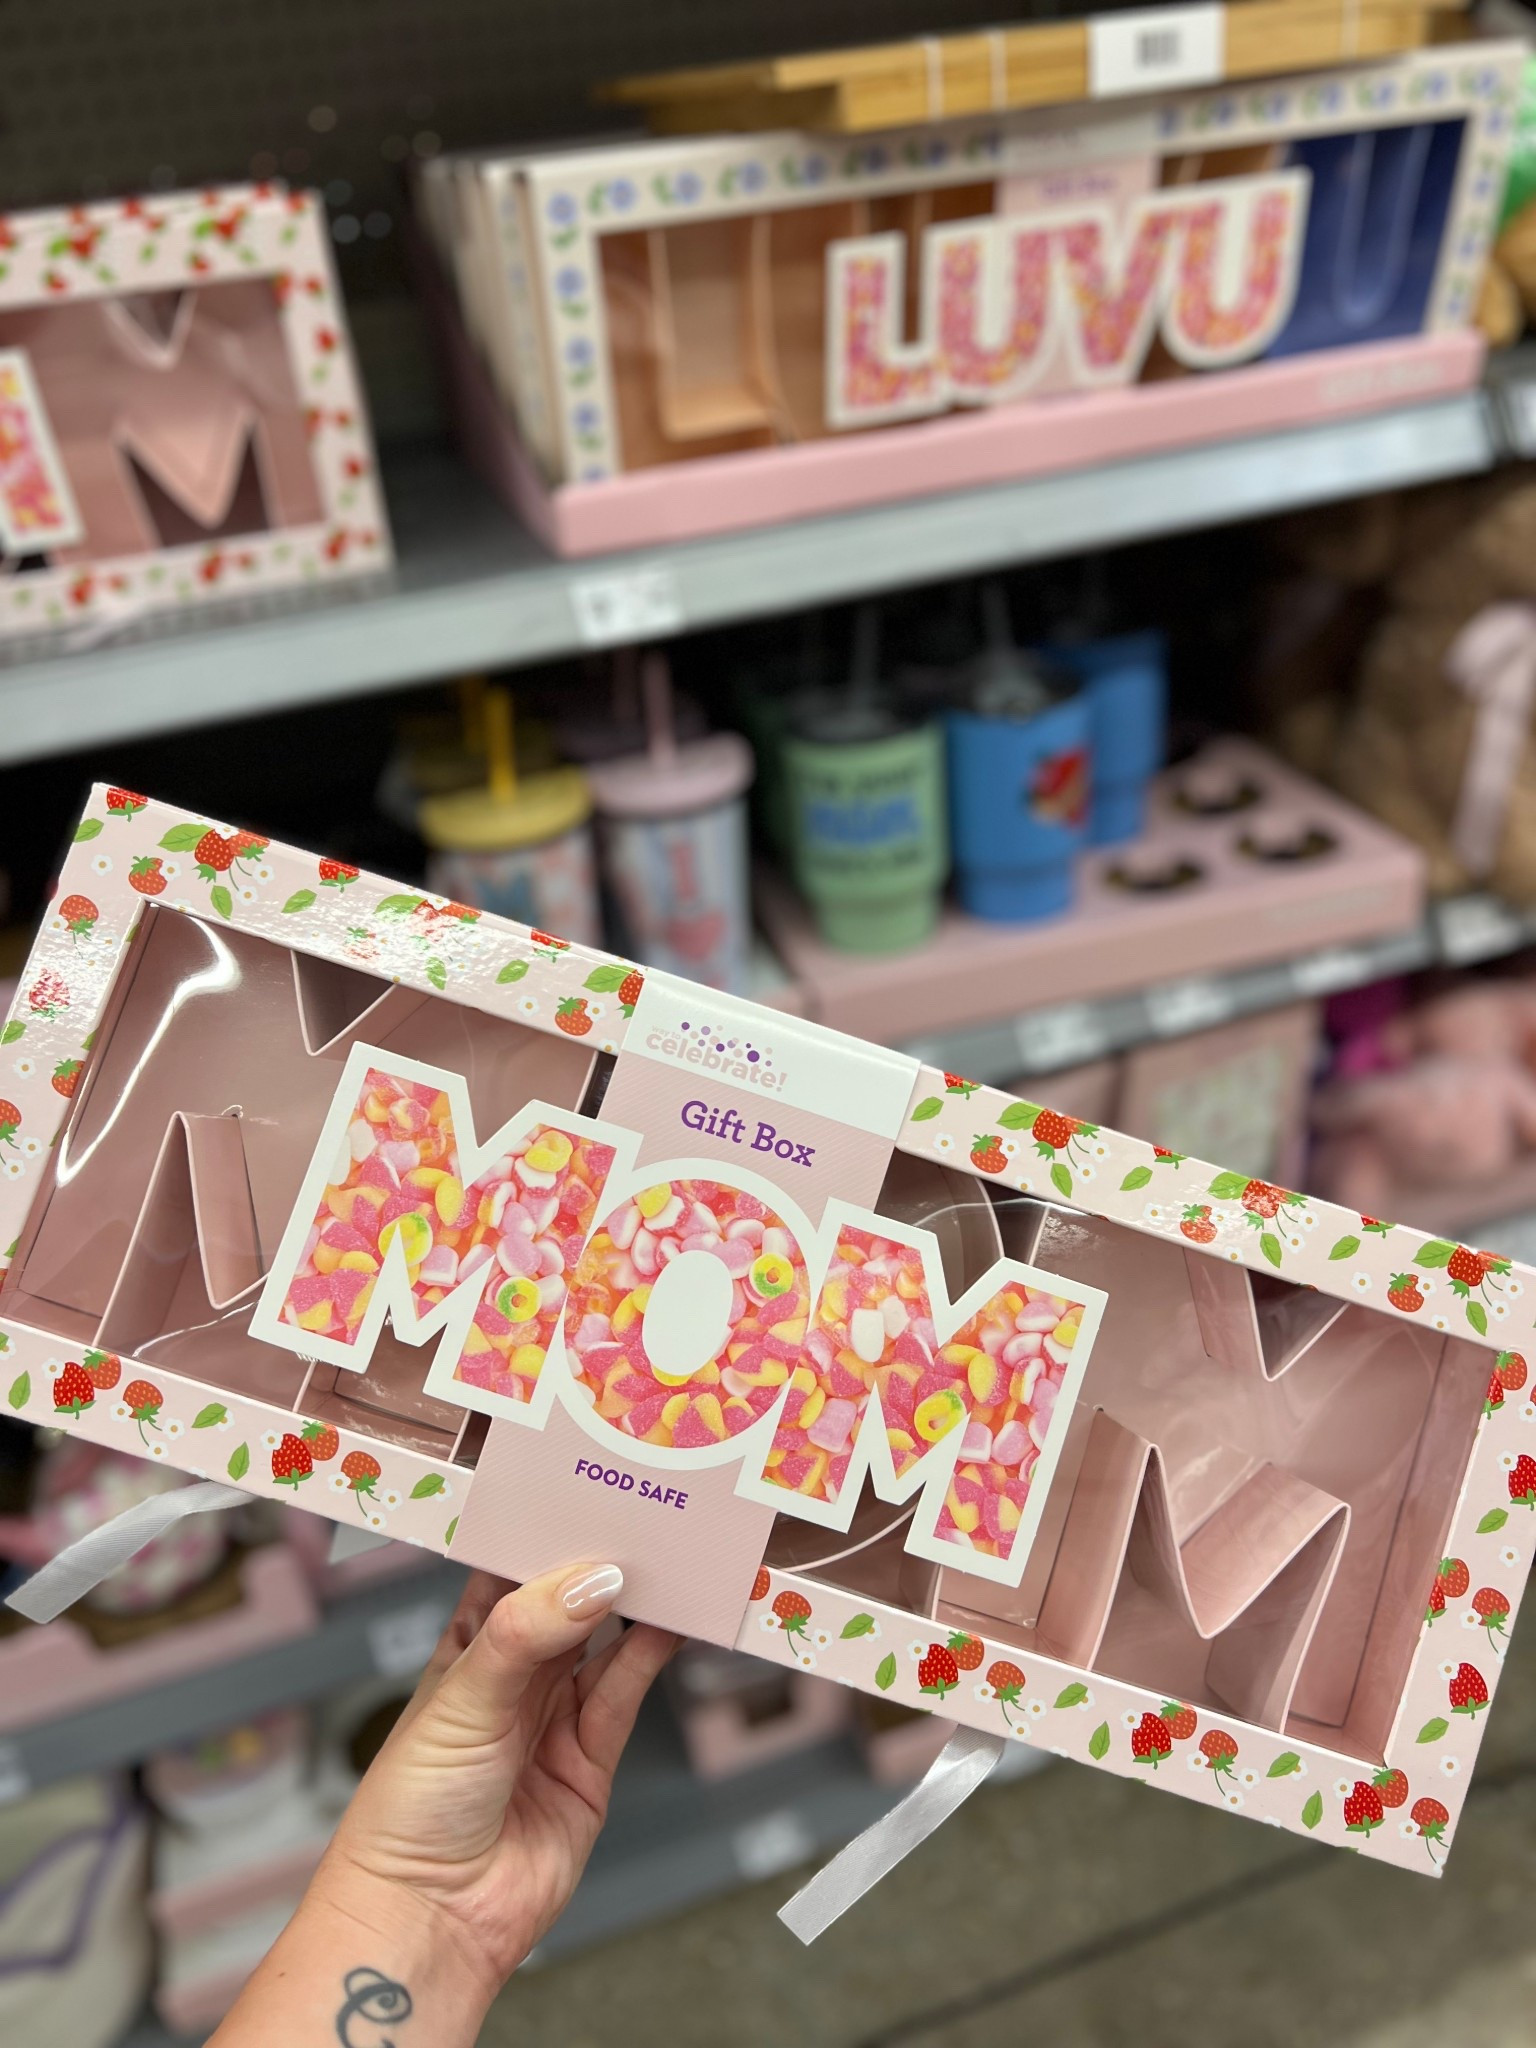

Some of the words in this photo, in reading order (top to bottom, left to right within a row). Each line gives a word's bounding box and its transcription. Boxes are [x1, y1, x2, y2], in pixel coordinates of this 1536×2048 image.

[652, 1025, 670, 1038] way
[646, 1033, 788, 1093] celebrate!
[681, 1100, 746, 1143] Gift
[750, 1121, 816, 1168] Box
[268, 1058, 1094, 1570] MOM
[574, 1458, 635, 1491] FOOD
[637, 1480, 689, 1510] SAFE
